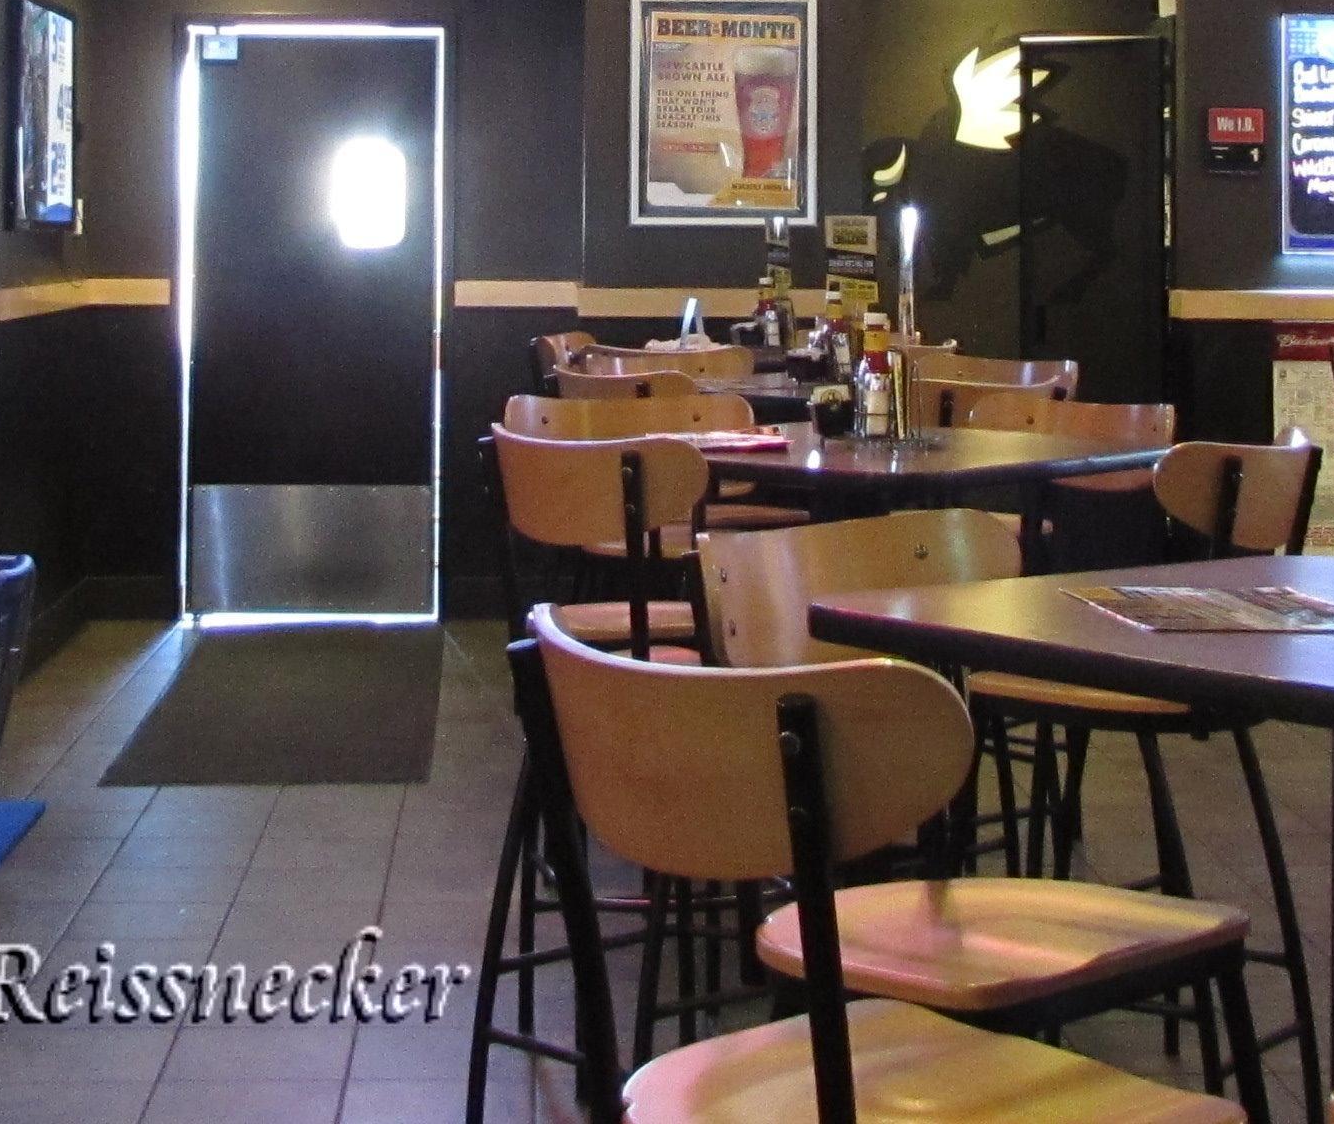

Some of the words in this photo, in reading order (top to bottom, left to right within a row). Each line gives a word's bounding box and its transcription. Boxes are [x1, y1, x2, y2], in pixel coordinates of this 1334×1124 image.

[657, 18, 710, 36] BEER
[721, 20, 796, 39] MONTH
[677, 90, 696, 98] ONE
[1216, 116, 1235, 132] We
